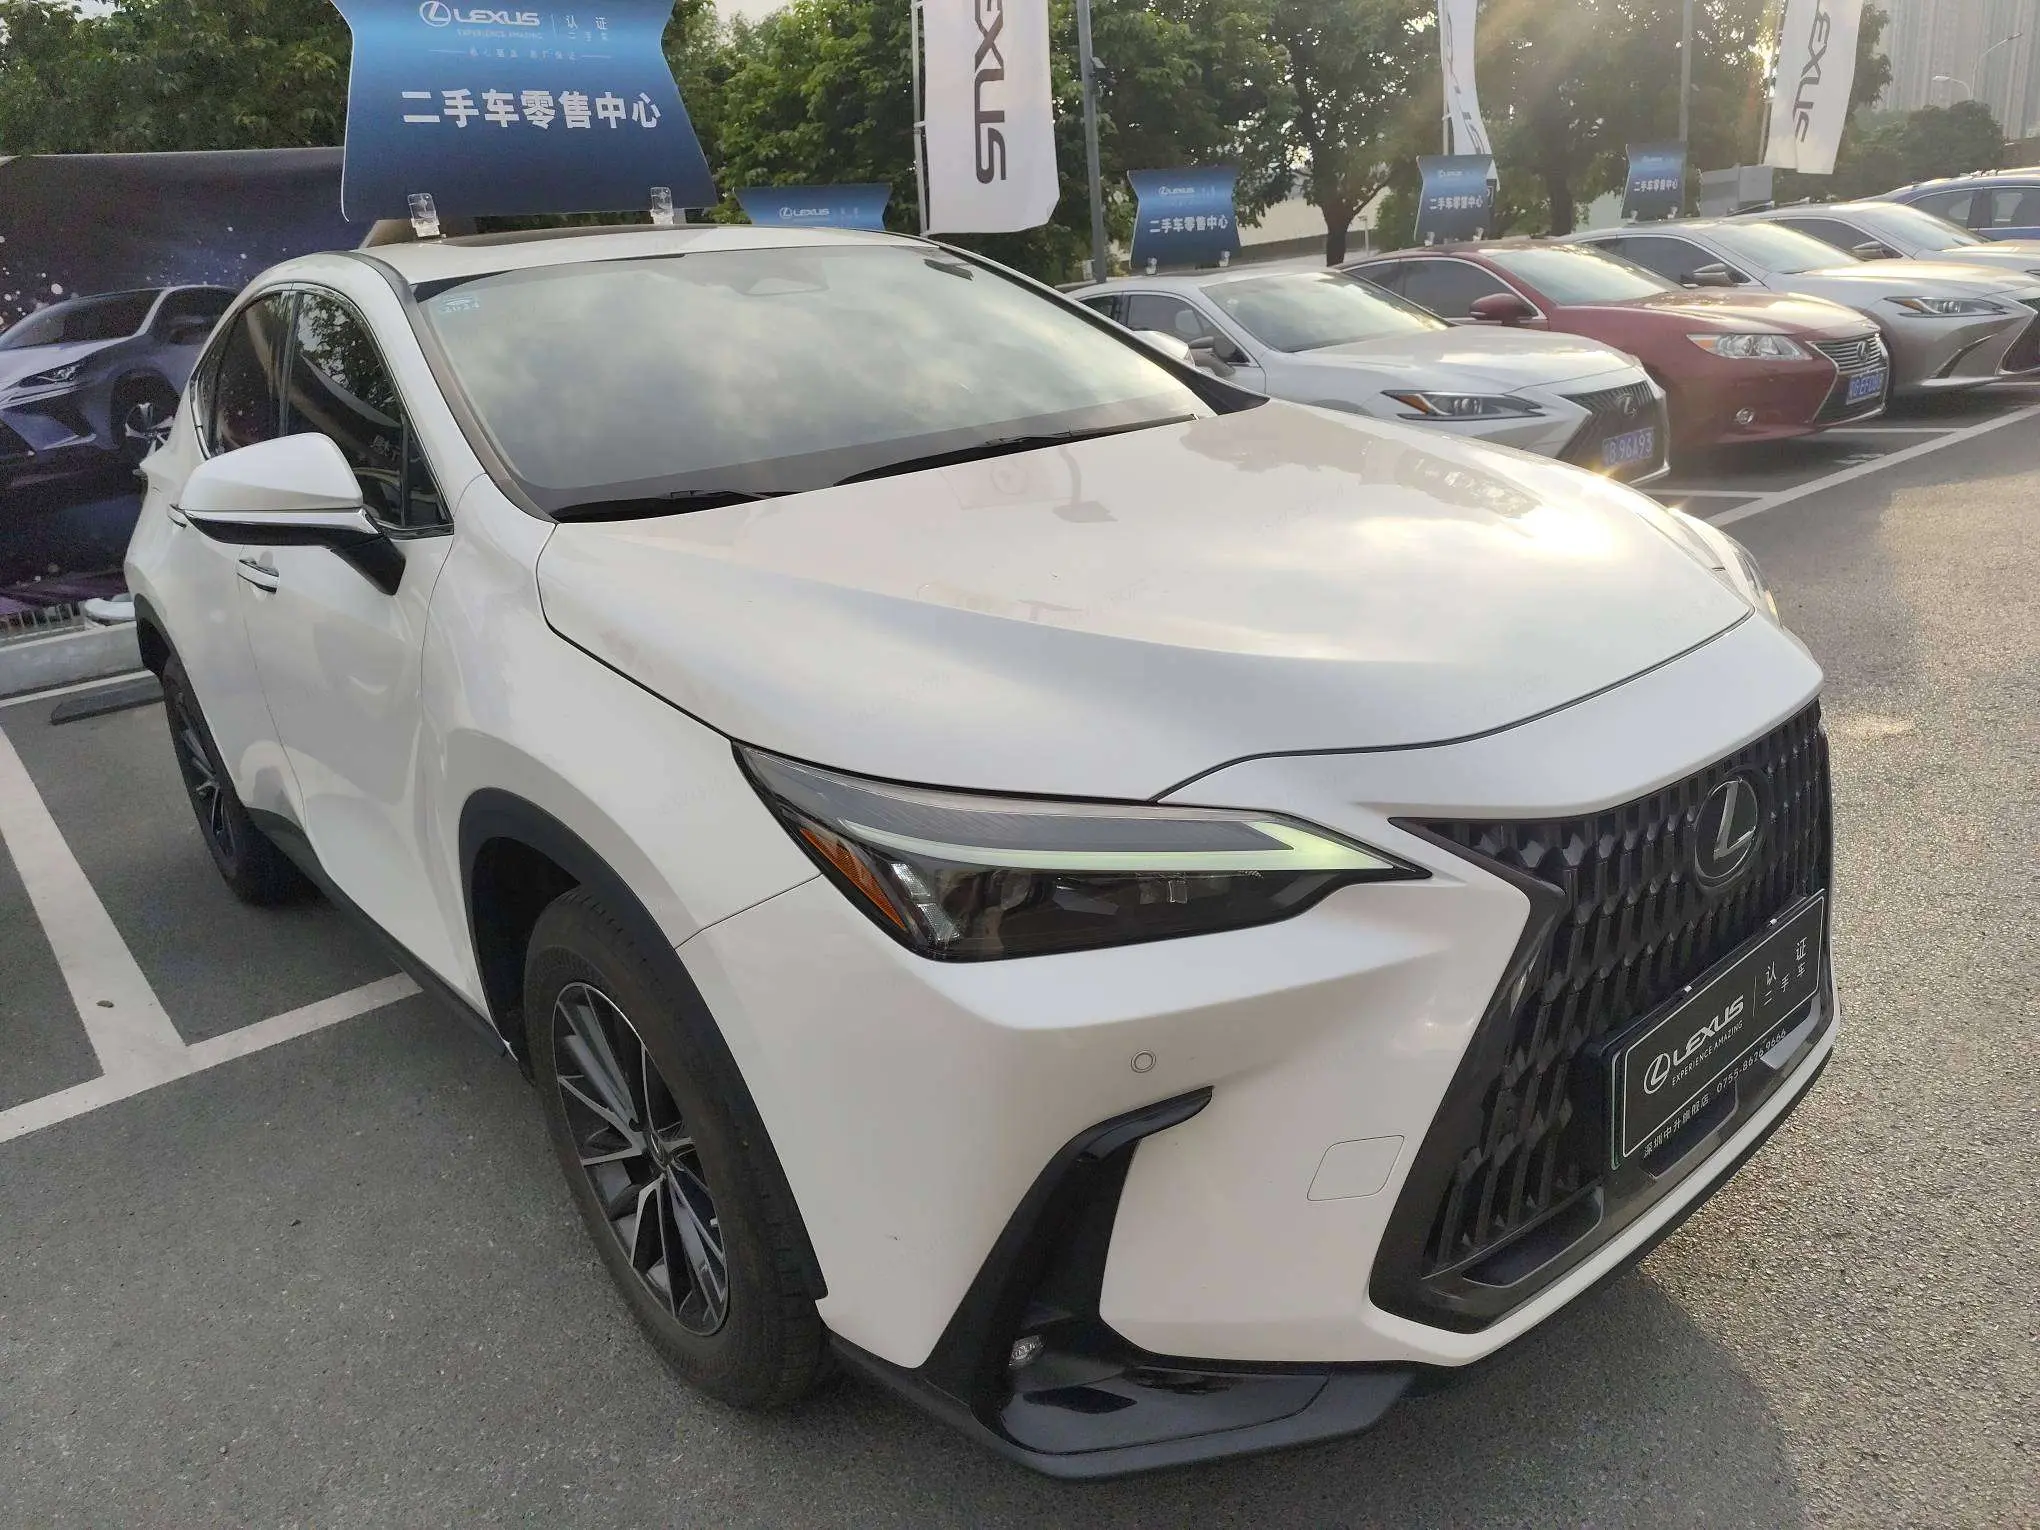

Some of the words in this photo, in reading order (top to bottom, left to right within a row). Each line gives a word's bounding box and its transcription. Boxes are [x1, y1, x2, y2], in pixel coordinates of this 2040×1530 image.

[453, 8, 541, 27] LEXUS
[401, 88, 662, 130] 二手车零售中心
[793, 208, 830, 216] LEXUS
[1149, 214, 1228, 233] 二手车零售中心
[1673, 994, 1744, 1066] LEXUS
[1672, 1045, 1713, 1086] EXPERIENCE
[1713, 1019, 1743, 1051] AMAZING
